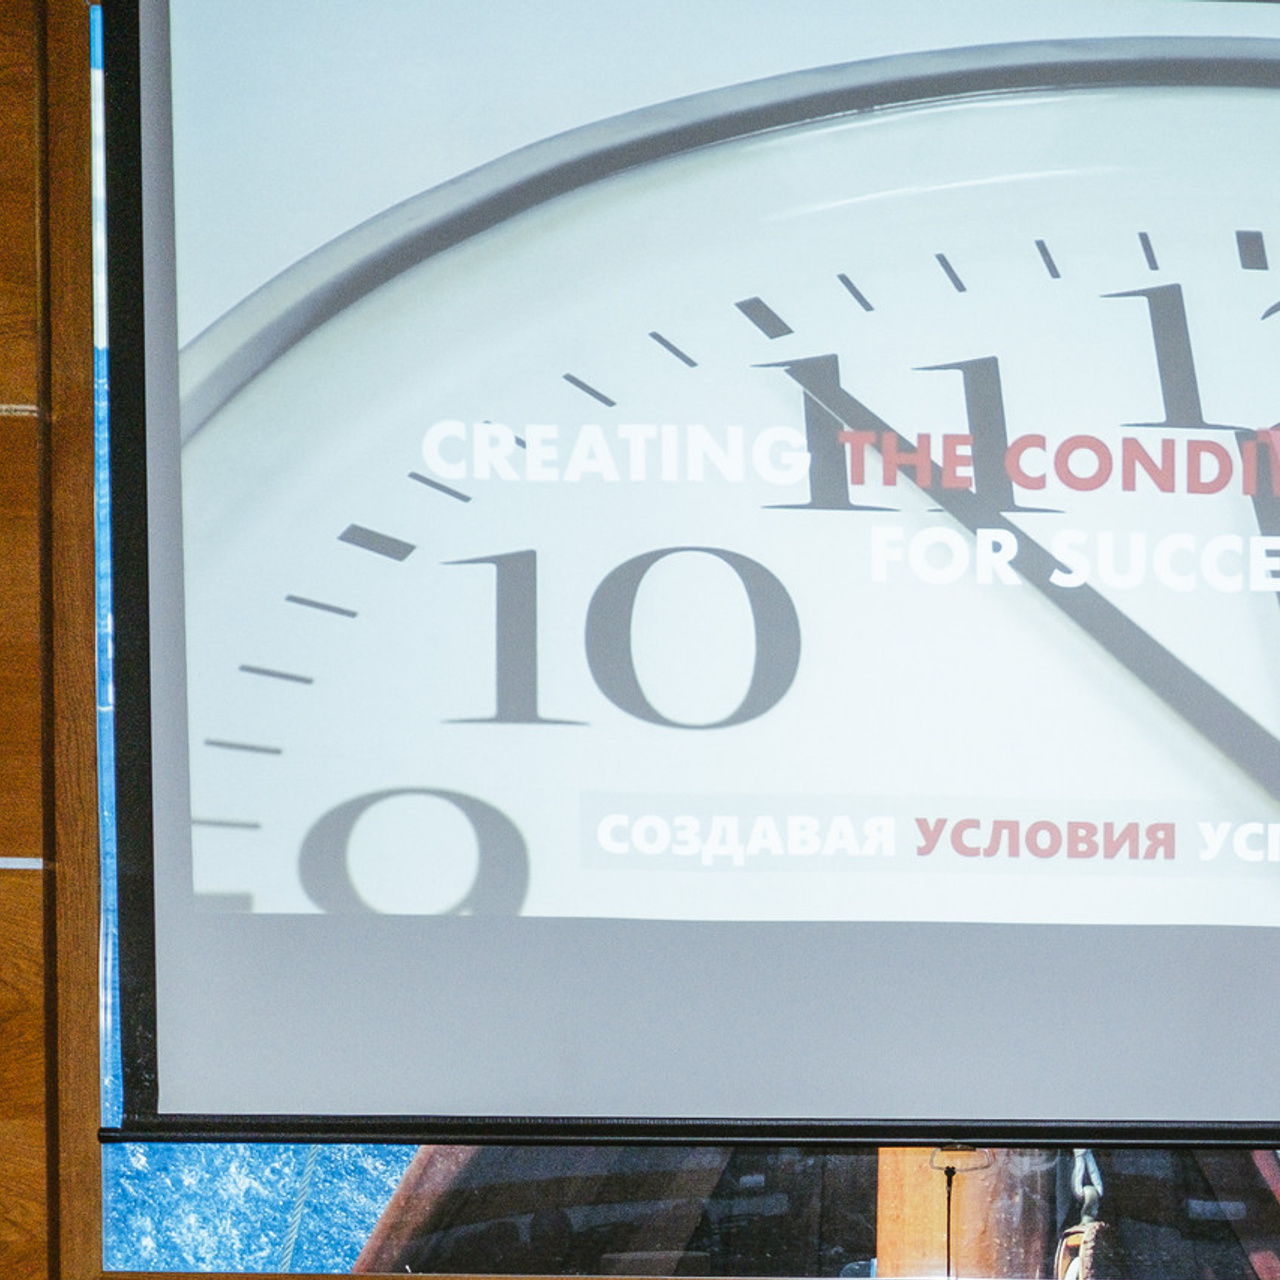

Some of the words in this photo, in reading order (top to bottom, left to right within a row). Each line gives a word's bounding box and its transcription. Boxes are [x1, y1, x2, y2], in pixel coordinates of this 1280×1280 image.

[420, 419, 812, 485] CREATING
[838, 430, 975, 491] THE
[870, 526, 1024, 587] FOR
[439, 545, 802, 731] 10
[596, 813, 896, 865] СОЗДАВАЯ
[914, 817, 1177, 861] УСЛОВИЯ
